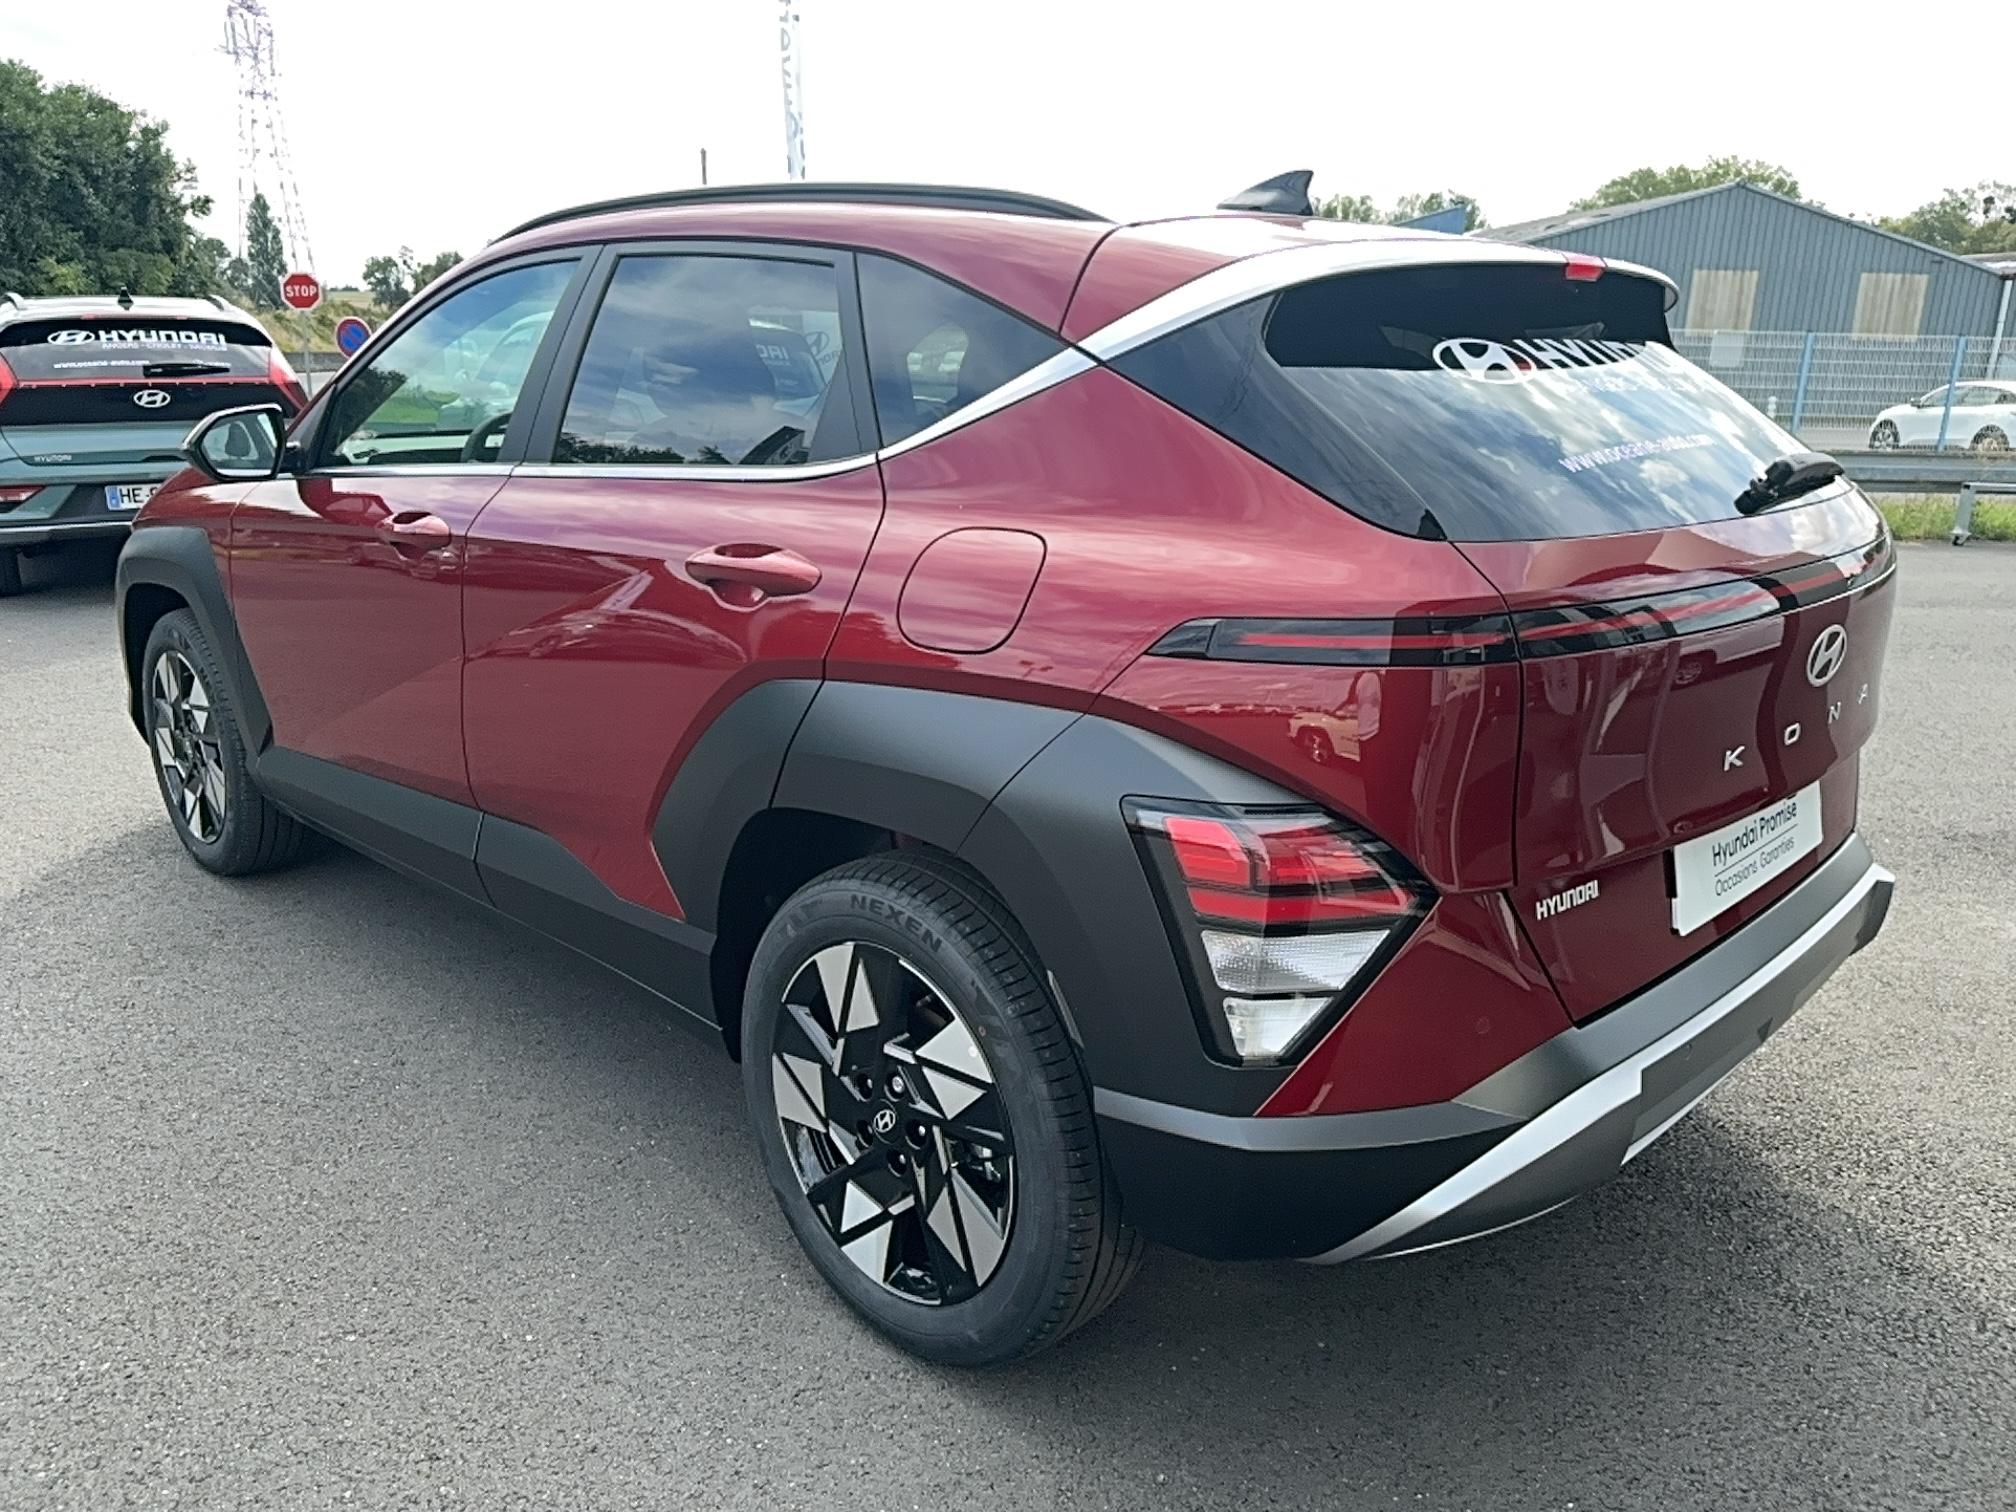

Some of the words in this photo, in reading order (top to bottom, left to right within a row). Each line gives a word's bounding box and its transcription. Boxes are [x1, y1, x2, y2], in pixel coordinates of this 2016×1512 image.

[285, 285, 317, 297] STOP
[98, 330, 227, 345] HYUNDAI
[1712, 819, 1758, 866] Hyundai
[1759, 802, 1797, 838] Promise
[1715, 861, 1757, 896] Occasions
[1536, 880, 1599, 920] HYUNDAI
[850, 894, 942, 952] NEXEN
